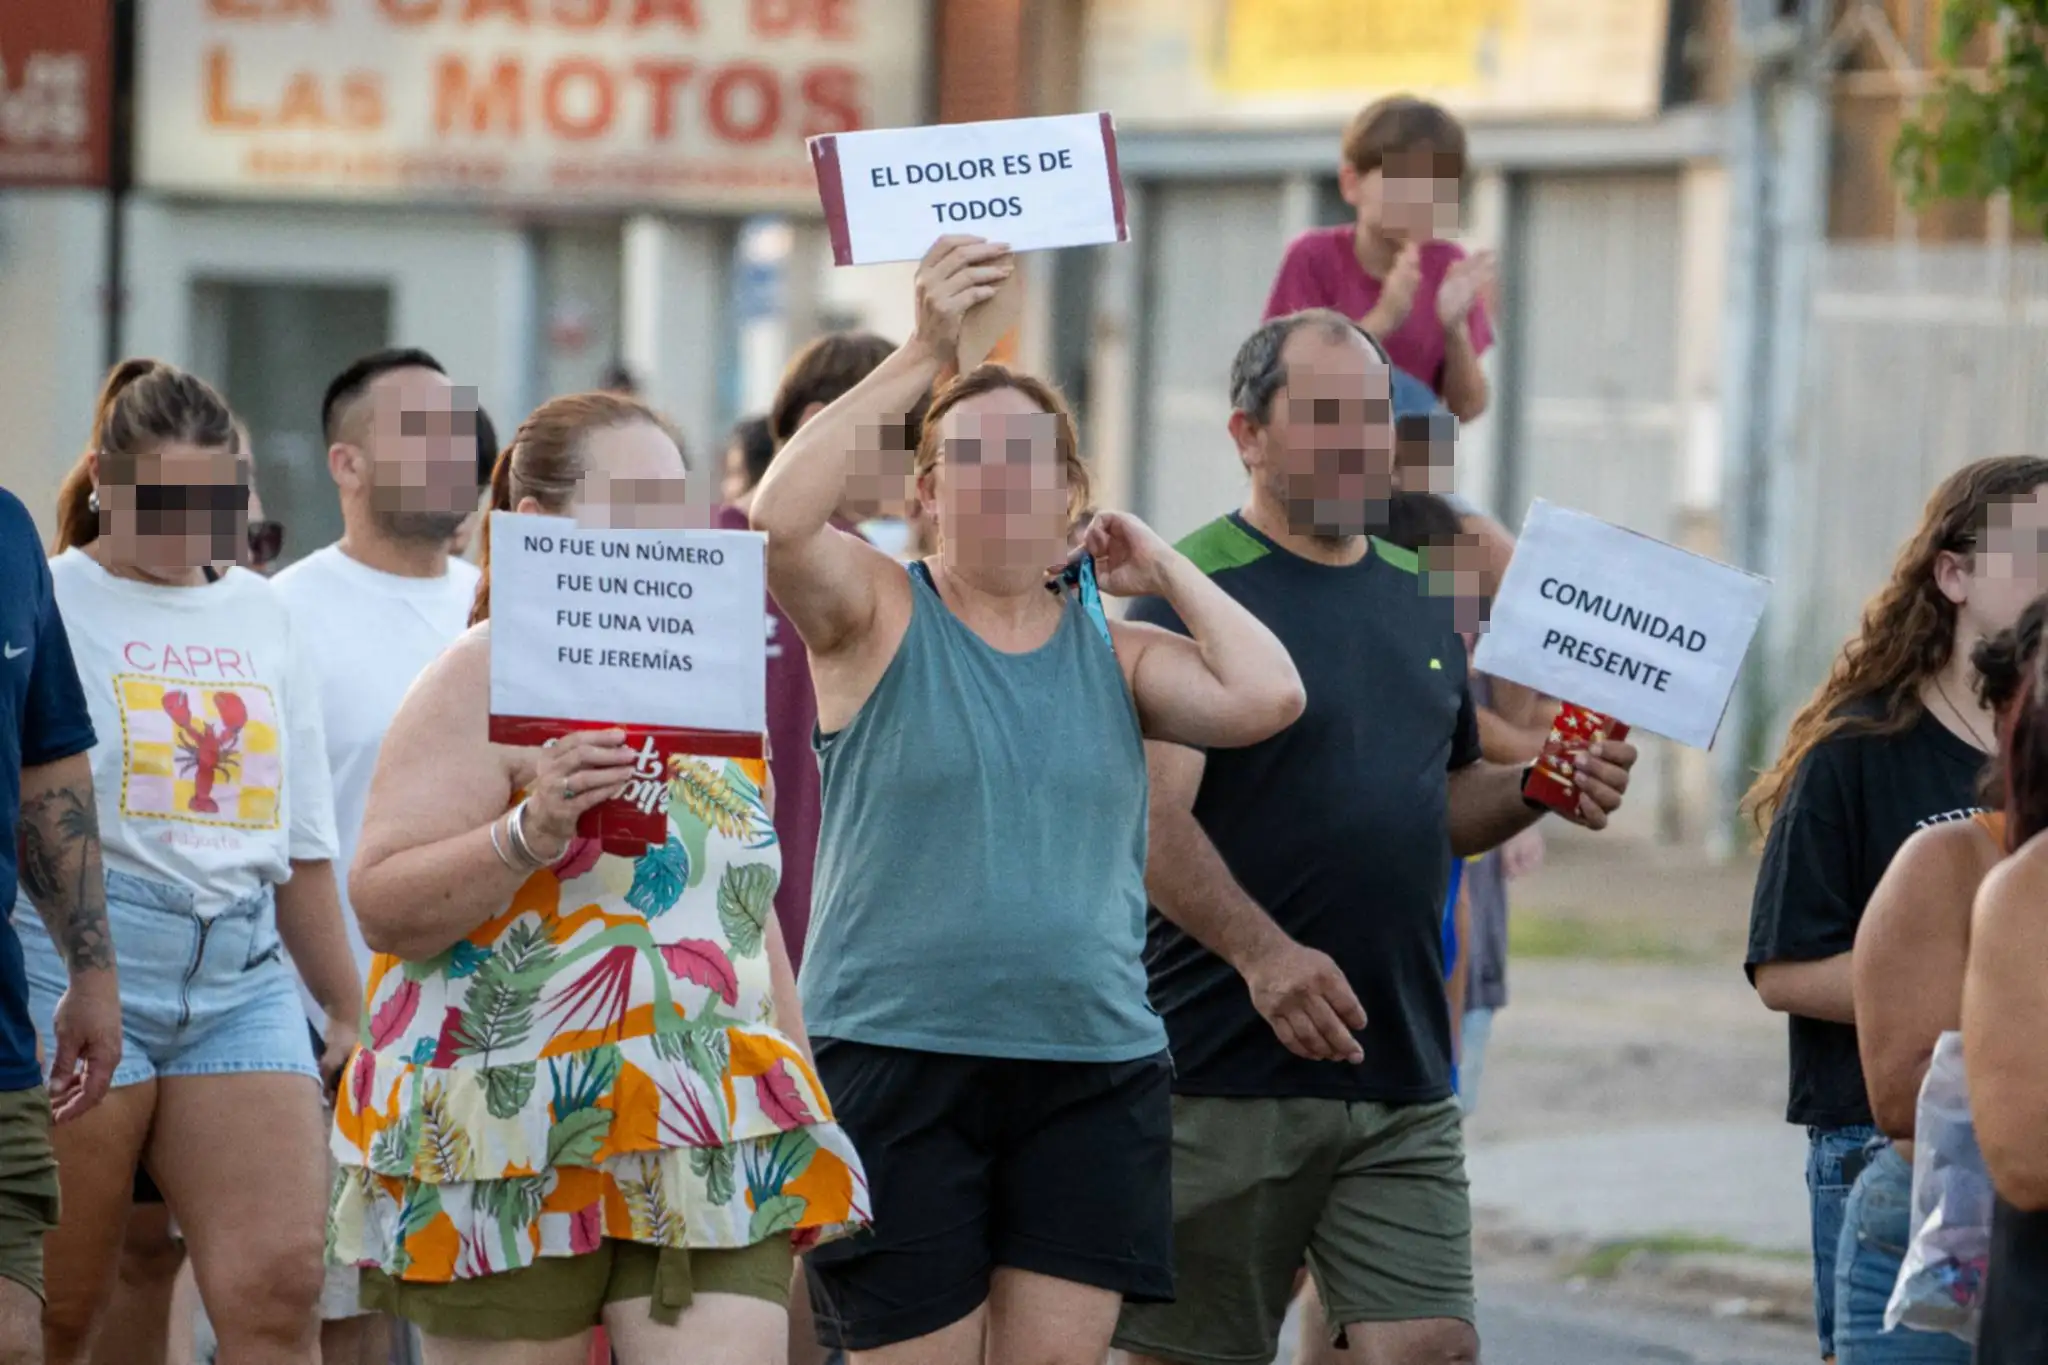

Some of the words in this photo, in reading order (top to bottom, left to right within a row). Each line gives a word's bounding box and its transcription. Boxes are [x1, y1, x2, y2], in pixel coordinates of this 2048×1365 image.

[438, 56, 862, 143] MOTOS
[870, 167, 899, 188] EL
[906, 158, 996, 183] DOLOR
[1003, 154, 1031, 176] ES
[1039, 149, 1073, 172] DE
[932, 196, 1022, 223] TODOS
[523, 535, 554, 553] NO
[559, 537, 595, 557] FUE
[602, 541, 630, 559] UN
[636, 541, 725, 566] NÚMERO
[557, 573, 593, 592] FUE
[598, 576, 628, 595] UN
[633, 578, 693, 599] CHICO
[556, 610, 592, 628] FUE
[598, 613, 641, 632] UNA
[647, 616, 694, 635] VIDA
[1539, 577, 1707, 653] COMUNIDAD
[124, 640, 258, 679] CAPRI
[558, 647, 593, 665] FUE
[599, 648, 693, 672] JEREMÍAS
[1542, 628, 1672, 692] PRESENTE
